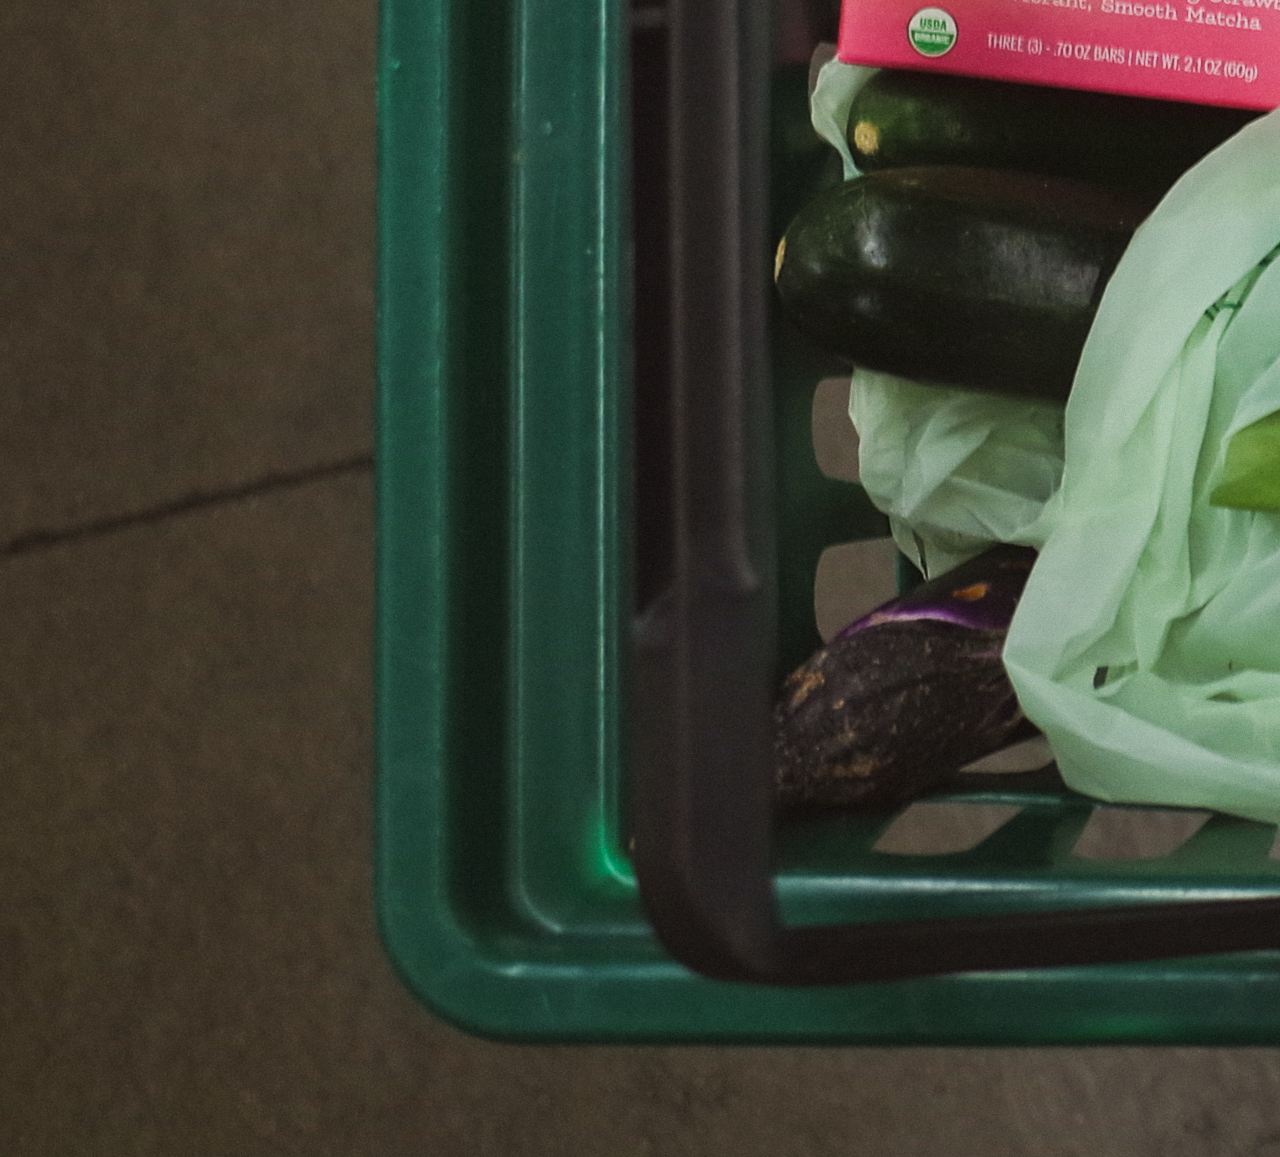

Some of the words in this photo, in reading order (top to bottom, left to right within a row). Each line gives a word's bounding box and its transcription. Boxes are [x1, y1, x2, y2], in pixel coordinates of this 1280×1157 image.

[919, 17, 947, 32] USDA
[1185, 6, 1263, 31] Matcha
[988, 34, 1024, 54] THREE
[1027, 38, 1043, 56] (3)
[1053, 42, 1073, 58] .70
[1074, 44, 1091, 61] OZ
[1094, 46, 1125, 66] BARS
[1135, 50, 1159, 69] NET
[1162, 54, 1180, 72] WT.
[1184, 56, 1202, 74] 2.1
[1204, 59, 1222, 77] OZ
[1224, 61, 1259, 83] (60g)
